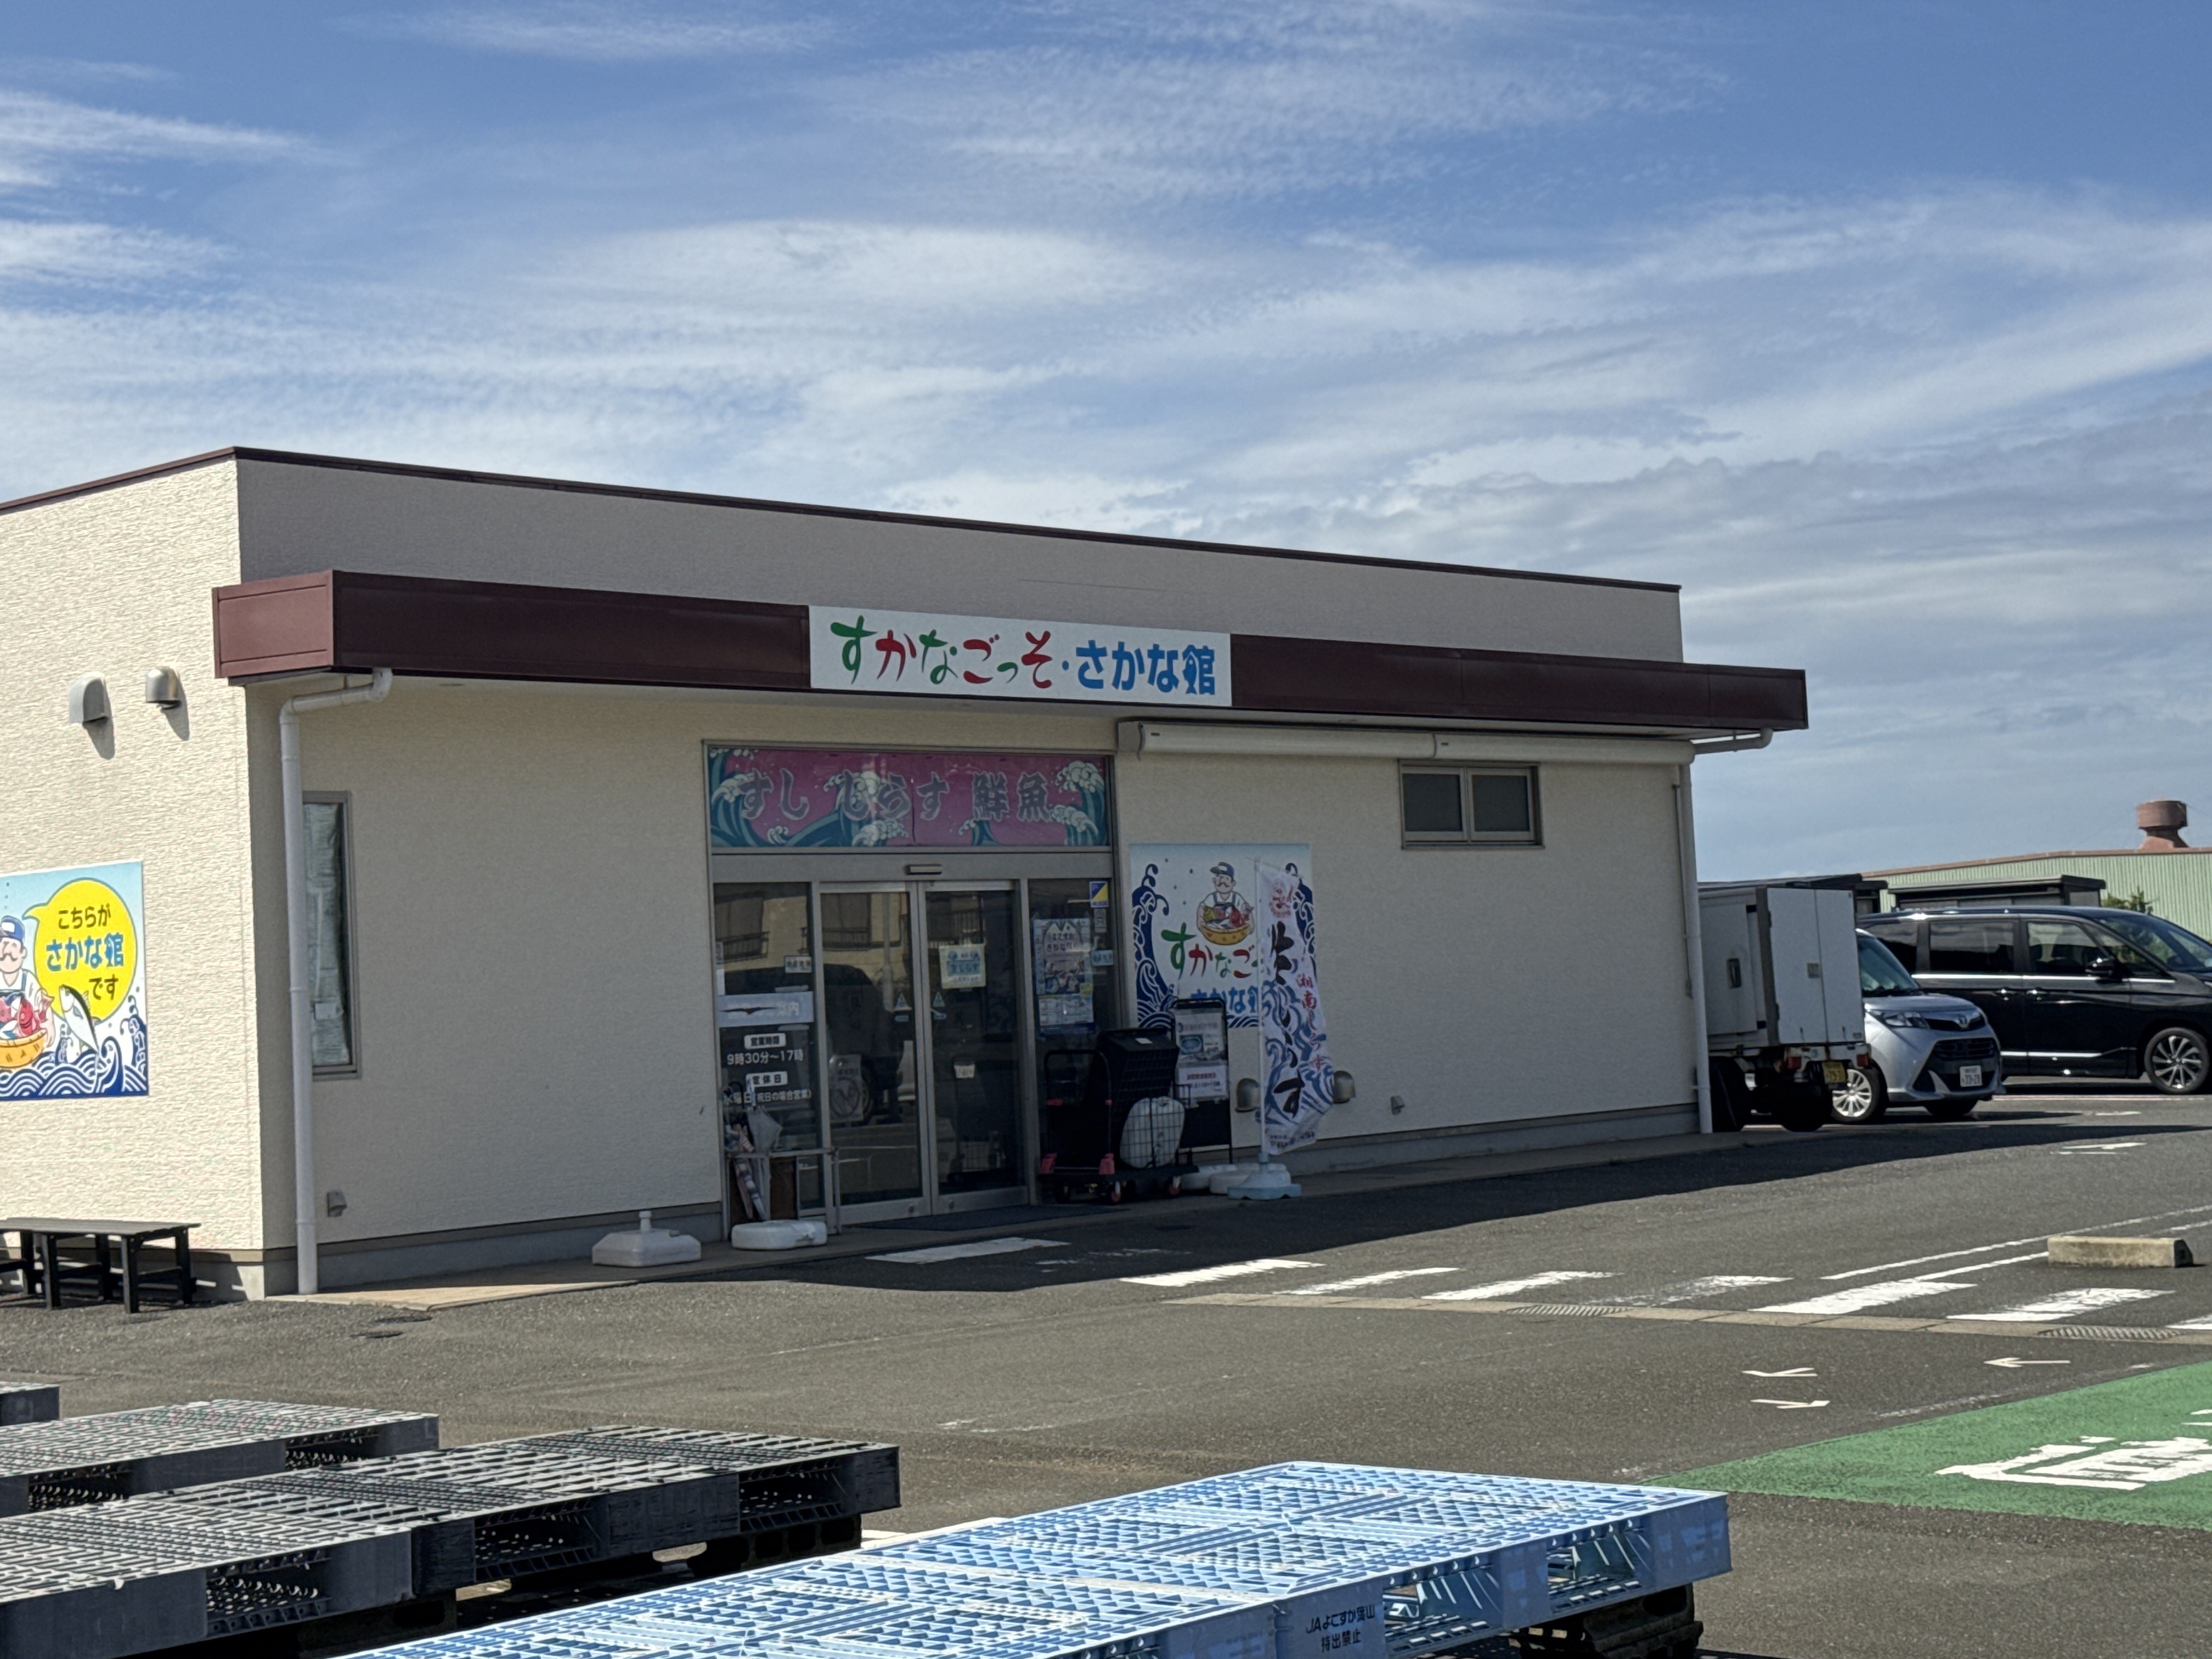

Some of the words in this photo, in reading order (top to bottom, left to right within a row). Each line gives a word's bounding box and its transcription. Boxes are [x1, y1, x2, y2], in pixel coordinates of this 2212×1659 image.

[738, 768, 810, 820] すし
[841, 769, 950, 822] しらす
[972, 771, 1051, 822] 鮮魚
[58, 903, 111, 930] こちらが
[46, 932, 125, 972] さかな館
[88, 974, 119, 1001] です
[753, 1074, 782, 1085] 定休日
[1306, 1604, 1375, 1634] JAよこすか葉山
[1321, 1628, 1362, 1652] 持出禁止
